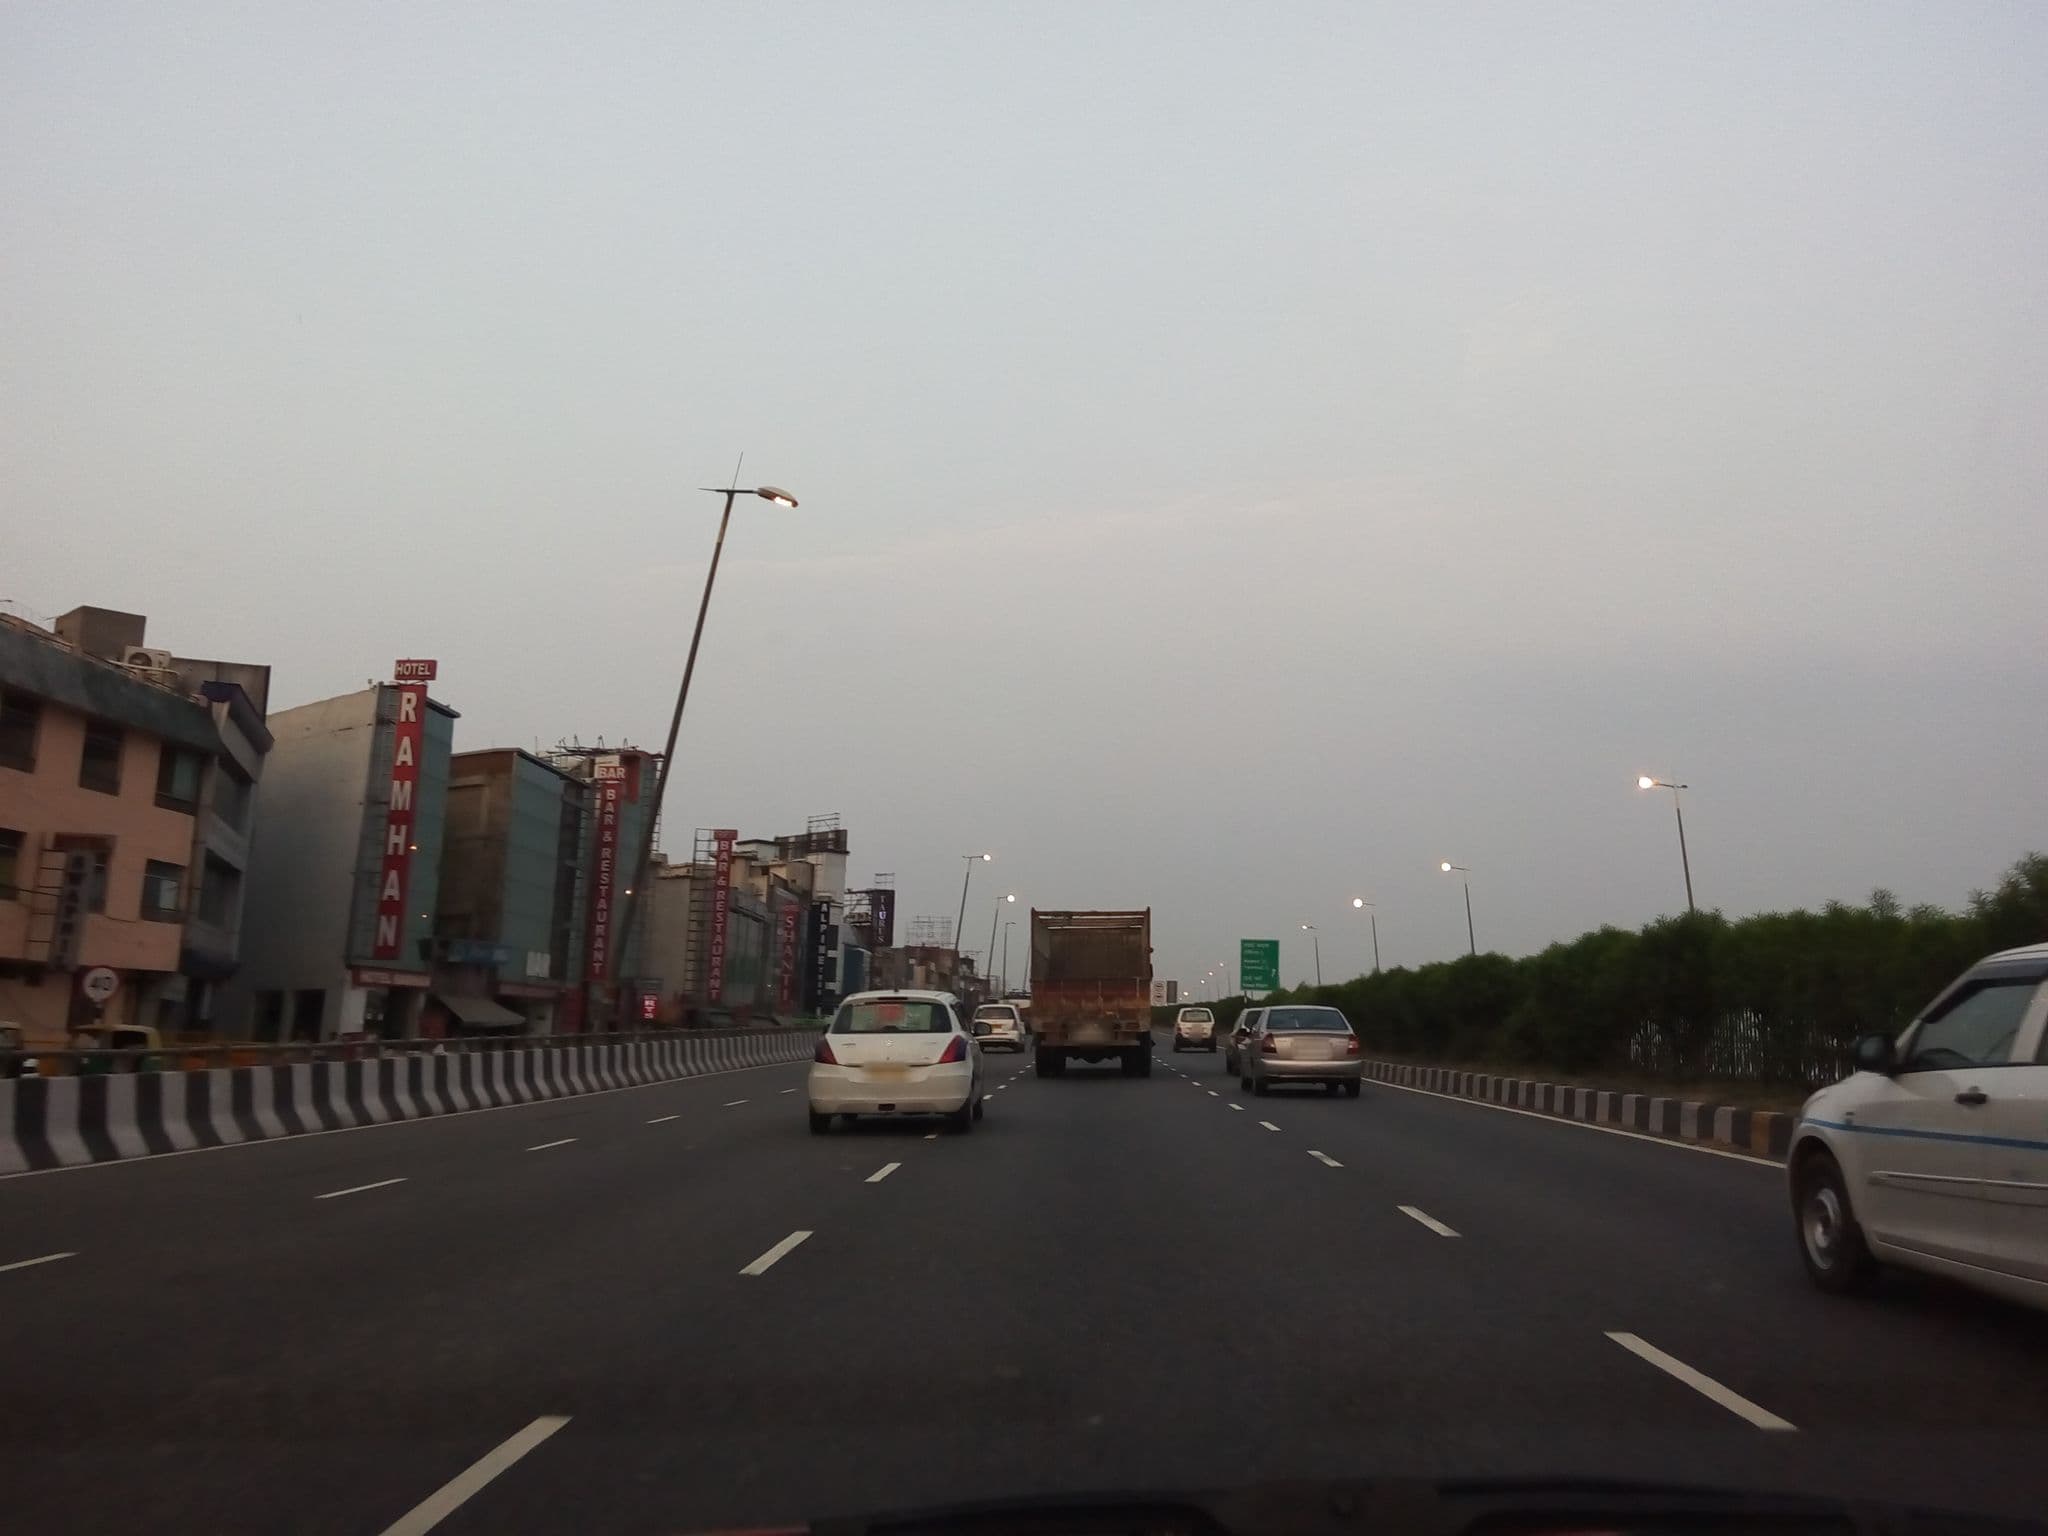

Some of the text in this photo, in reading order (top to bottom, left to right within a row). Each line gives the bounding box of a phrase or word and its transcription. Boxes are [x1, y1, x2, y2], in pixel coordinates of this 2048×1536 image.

[396, 662, 431, 676] HOTEL
[598, 767, 626, 779] BAR
[376, 691, 418, 947] RAMHAN
[604, 789, 616, 826] BAR
[717, 840, 730, 872] BAR
[592, 847, 612, 975] RESTAURANT
[709, 890, 727, 1000] RESTAURANT
[782, 915, 795, 1001] SHANTI
